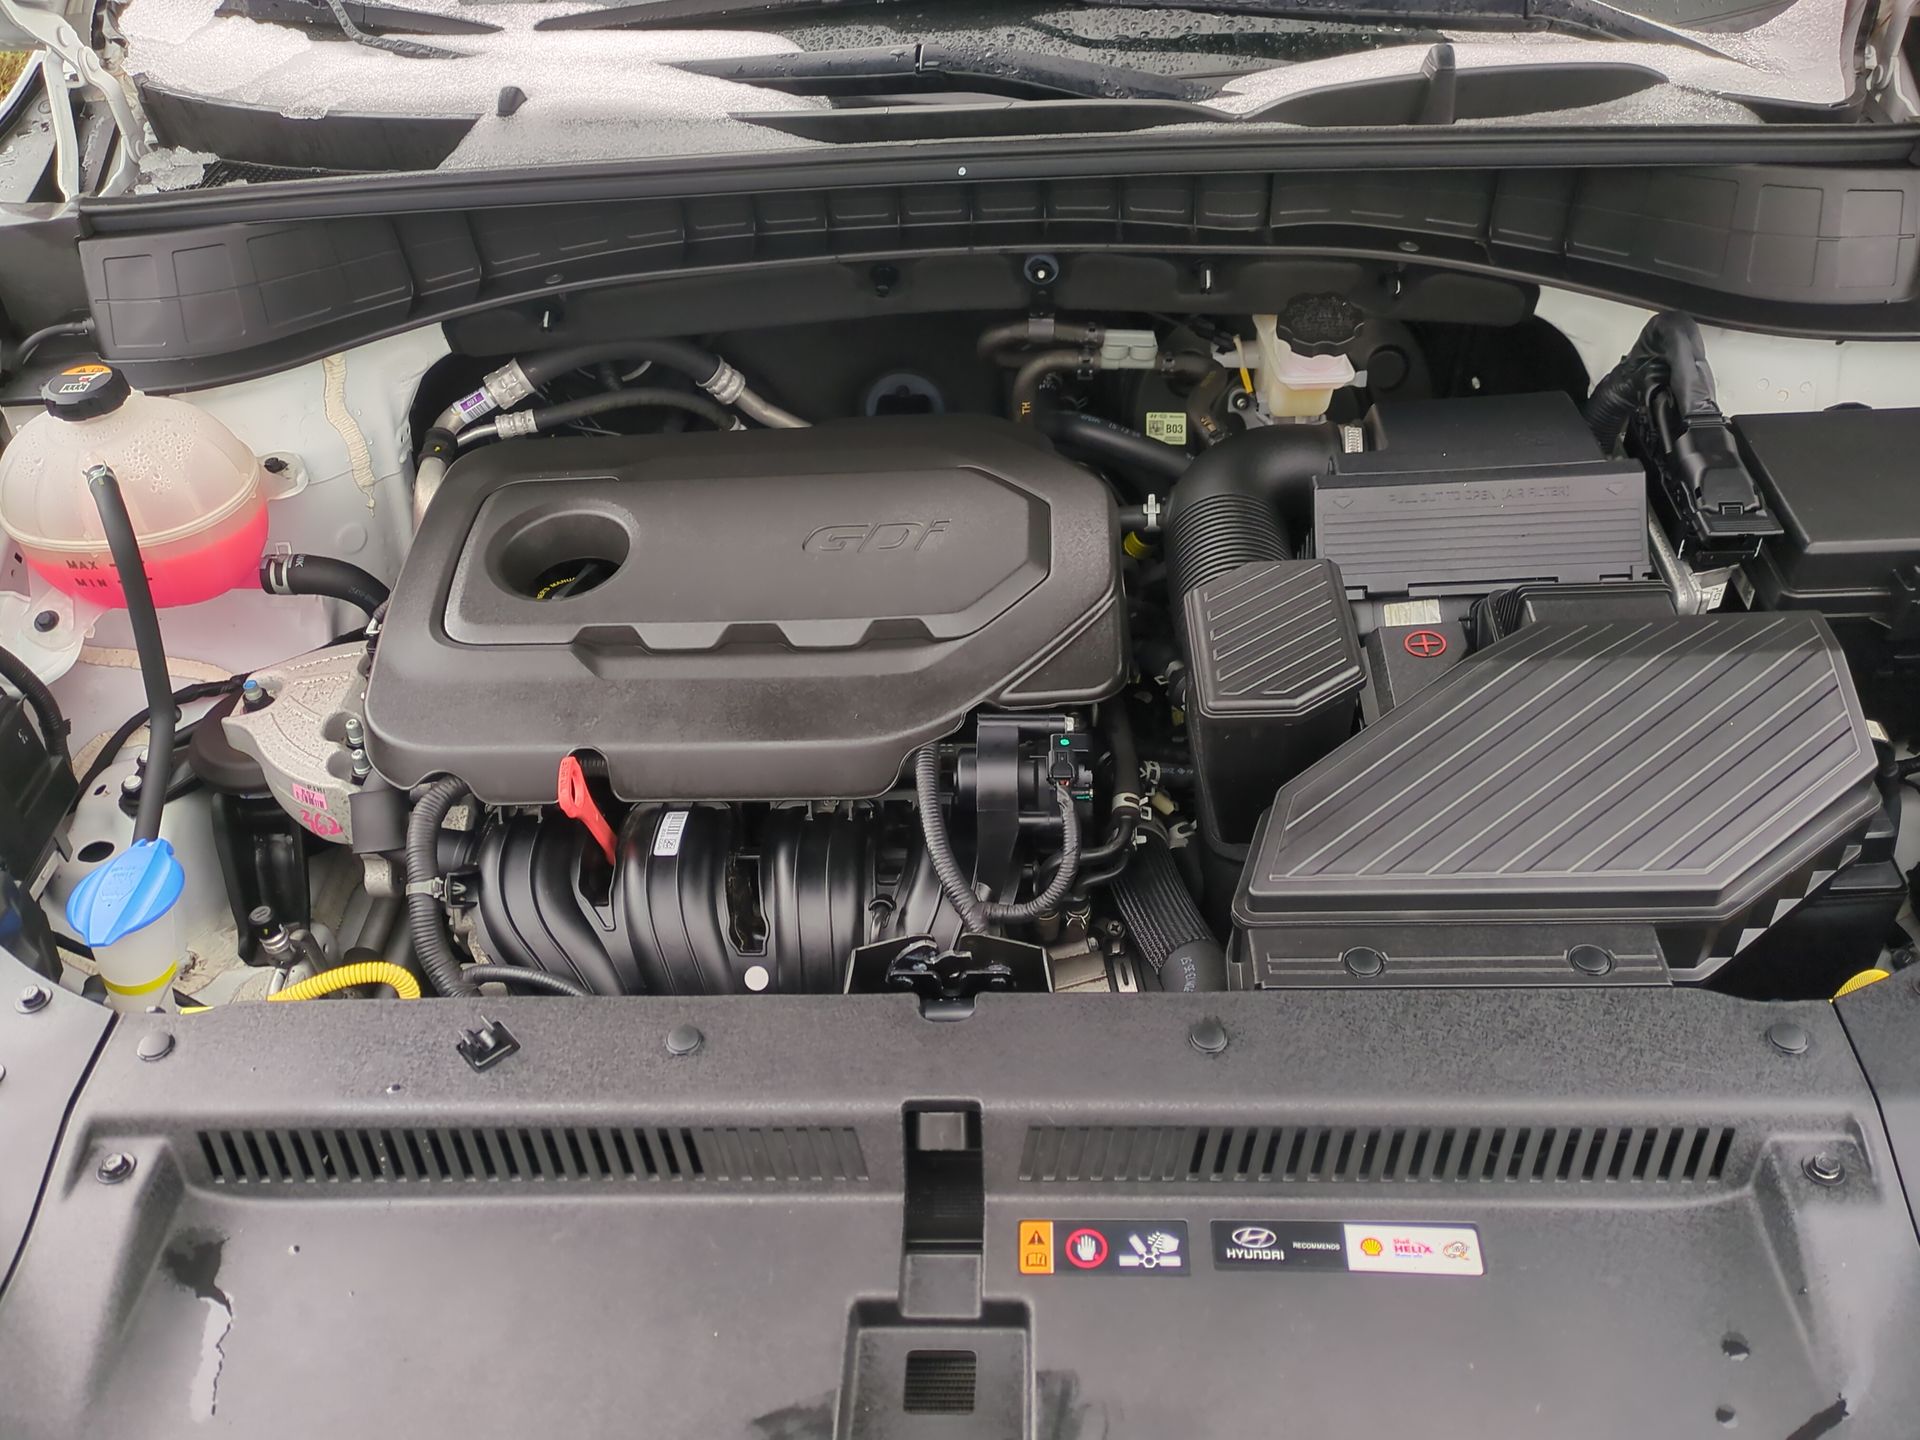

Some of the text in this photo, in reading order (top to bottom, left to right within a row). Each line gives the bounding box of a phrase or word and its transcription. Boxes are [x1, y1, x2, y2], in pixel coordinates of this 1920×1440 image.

[1166, 423, 1184, 434] B03
[65, 560, 98, 570] MAX
[74, 578, 108, 588] MIN
[1292, 1241, 1341, 1251] RECOMMENDS
[1393, 1244, 1434, 1254] HELIX
[1226, 1248, 1285, 1261] HYUNDAI
